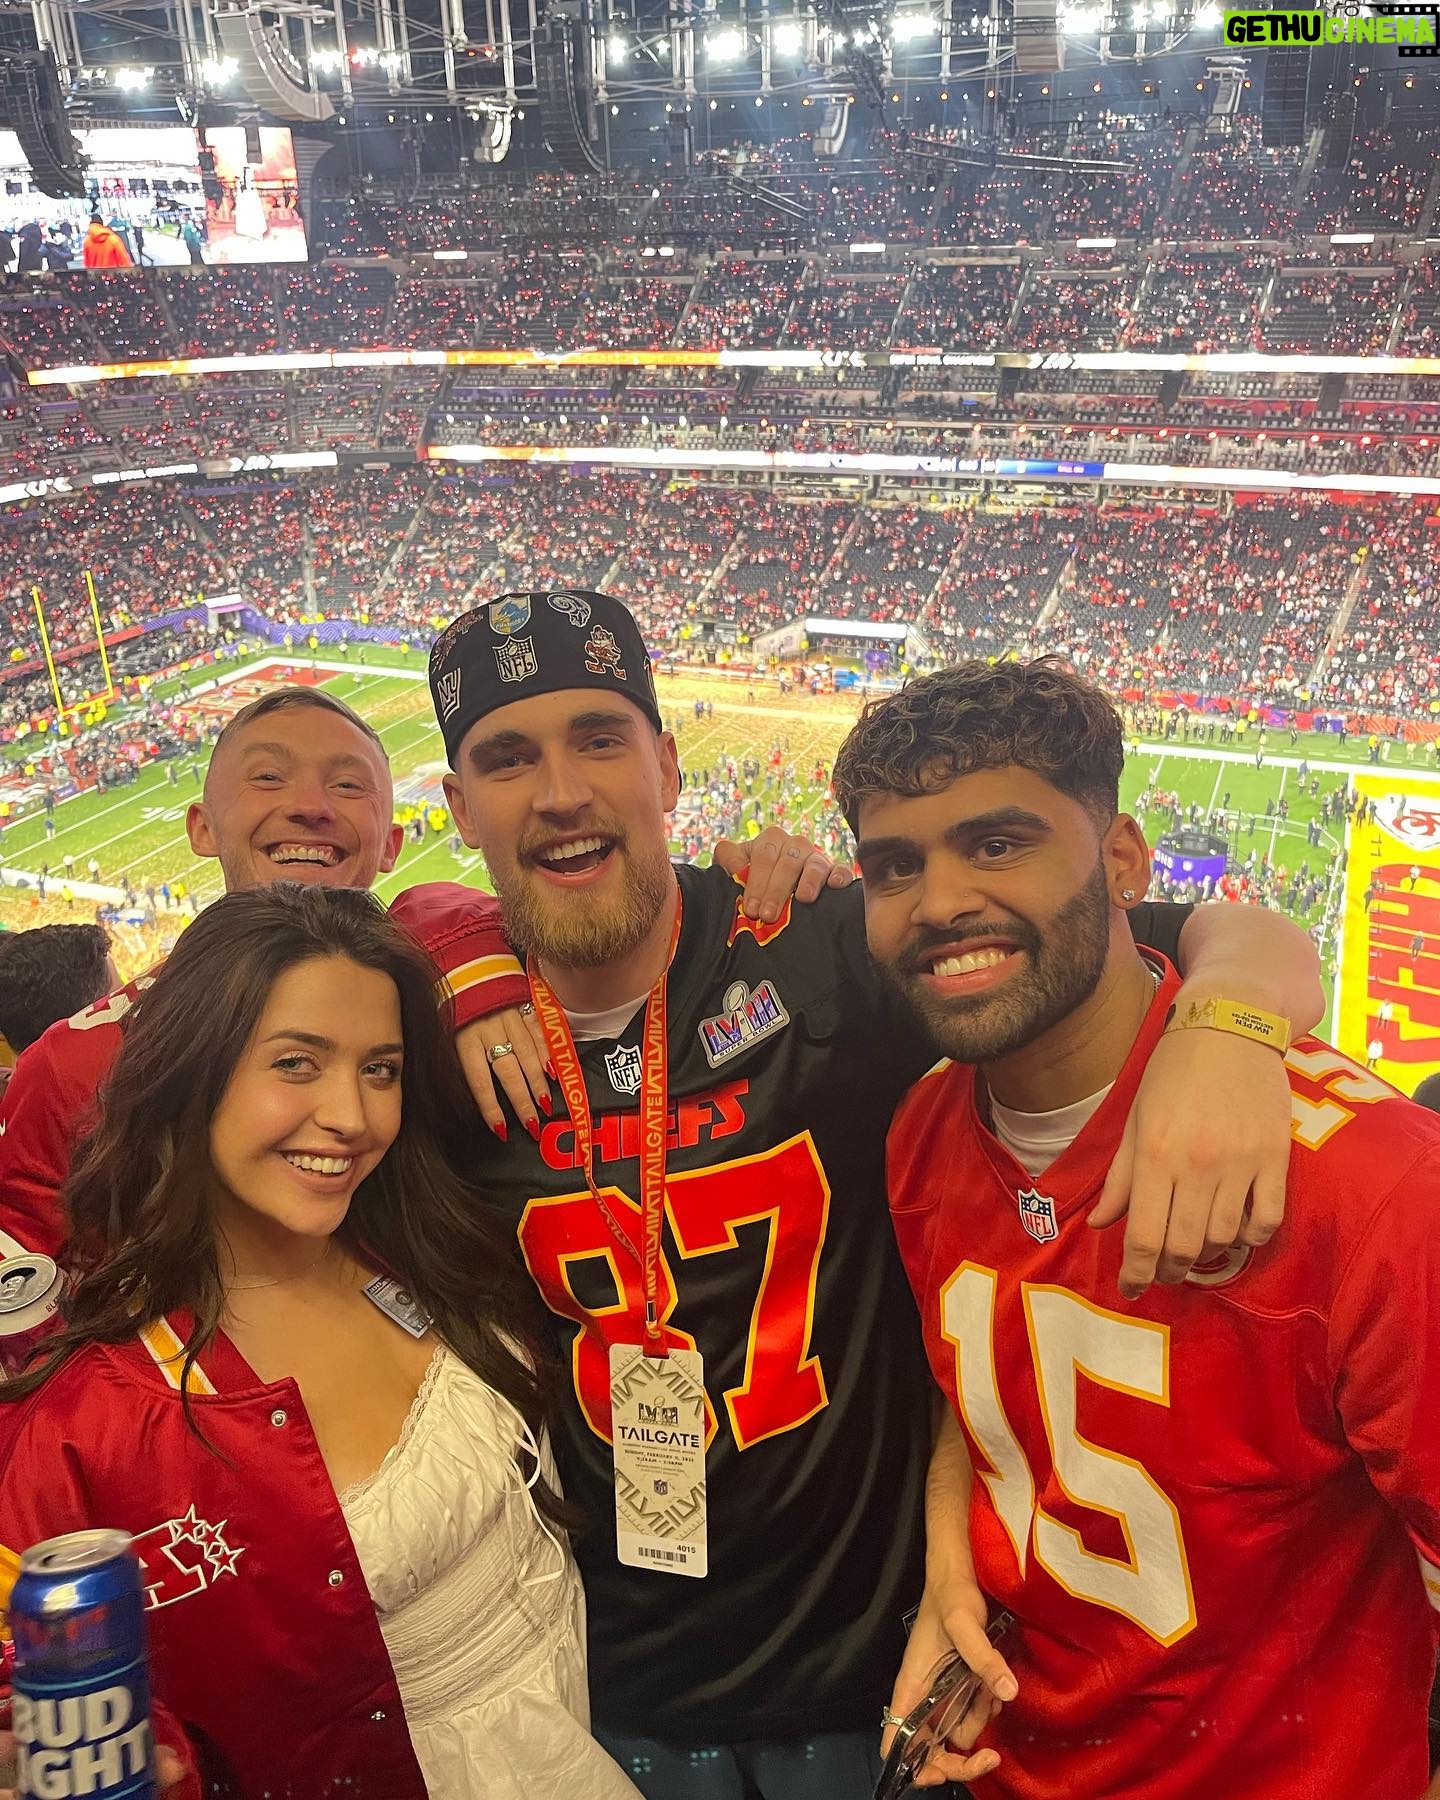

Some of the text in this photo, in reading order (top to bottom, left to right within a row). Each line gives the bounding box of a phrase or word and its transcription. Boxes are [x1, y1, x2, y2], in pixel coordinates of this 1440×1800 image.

[501, 658, 534, 679] NFL
[718, 1020, 778, 1057] SUPER BOWL
[1235, 1018, 1270, 1036] NW PEN
[614, 1066, 641, 1088] NFL
[645, 1093, 664, 1188] TAILGATE
[1022, 1212, 1052, 1237] NFL
[516, 1130, 832, 1453] 87
[618, 1425, 700, 1448] TAILGATE
[939, 1259, 1198, 1649] 15
[676, 1545, 696, 1554] 4015
[12, 1685, 133, 1748] BUD
[18, 1717, 150, 1800] IGHT
